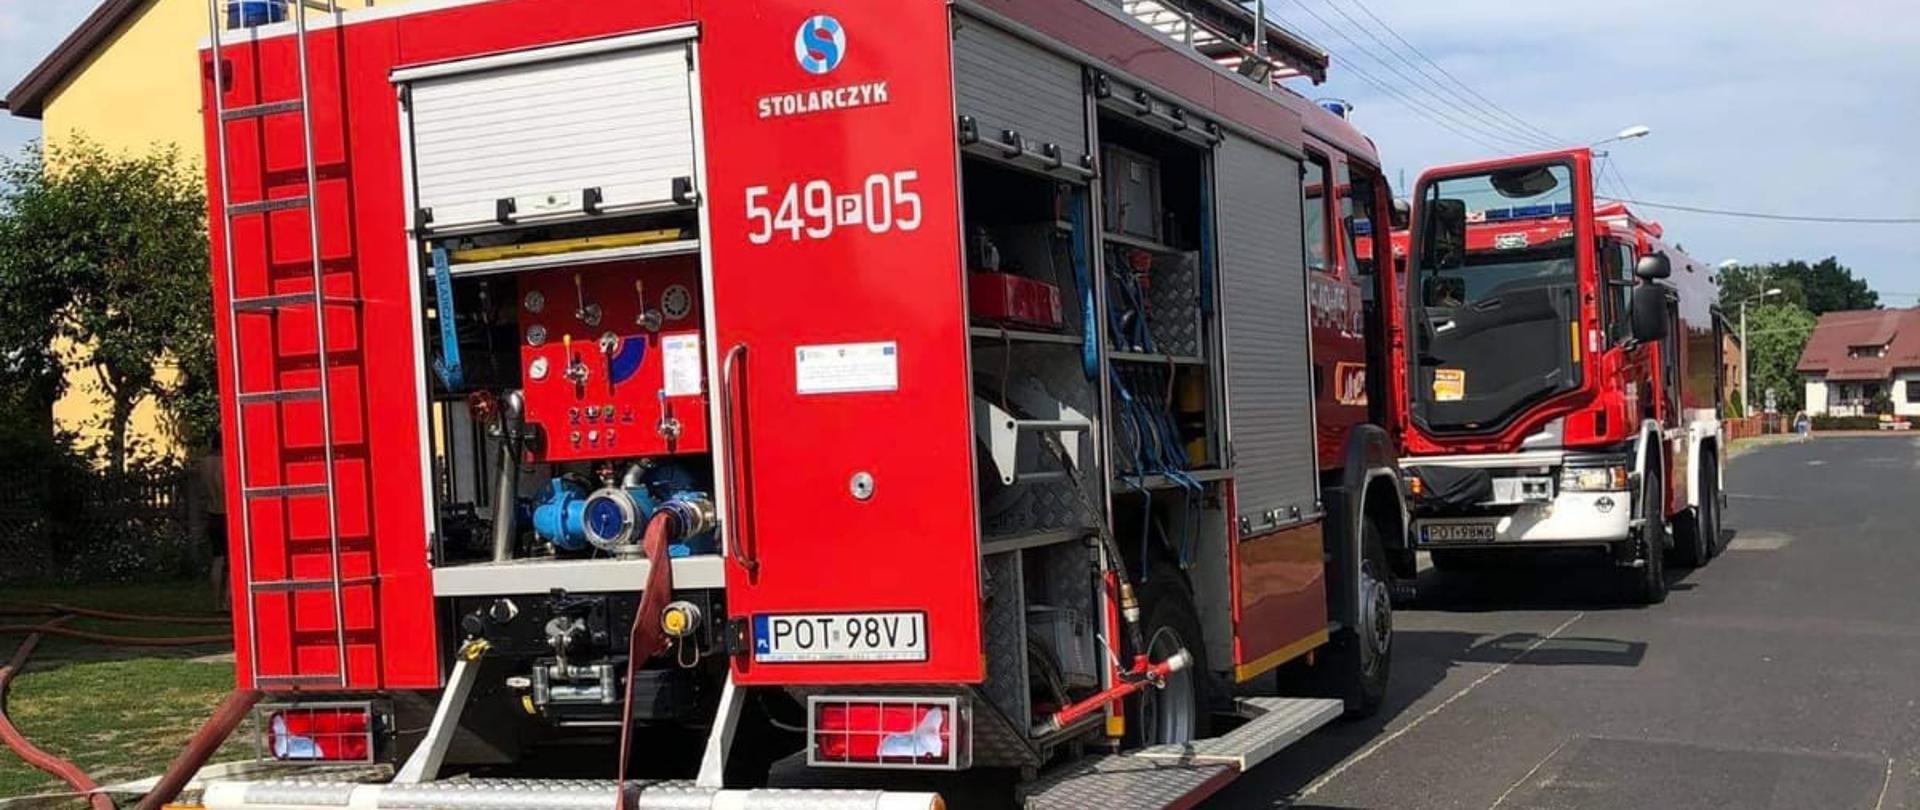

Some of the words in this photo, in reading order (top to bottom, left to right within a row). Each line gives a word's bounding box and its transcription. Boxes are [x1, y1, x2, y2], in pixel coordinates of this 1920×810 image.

[758, 82, 889, 118] STOLARCZYK
[773, 618, 834, 650] POT
[846, 616, 918, 649] 98VJ
